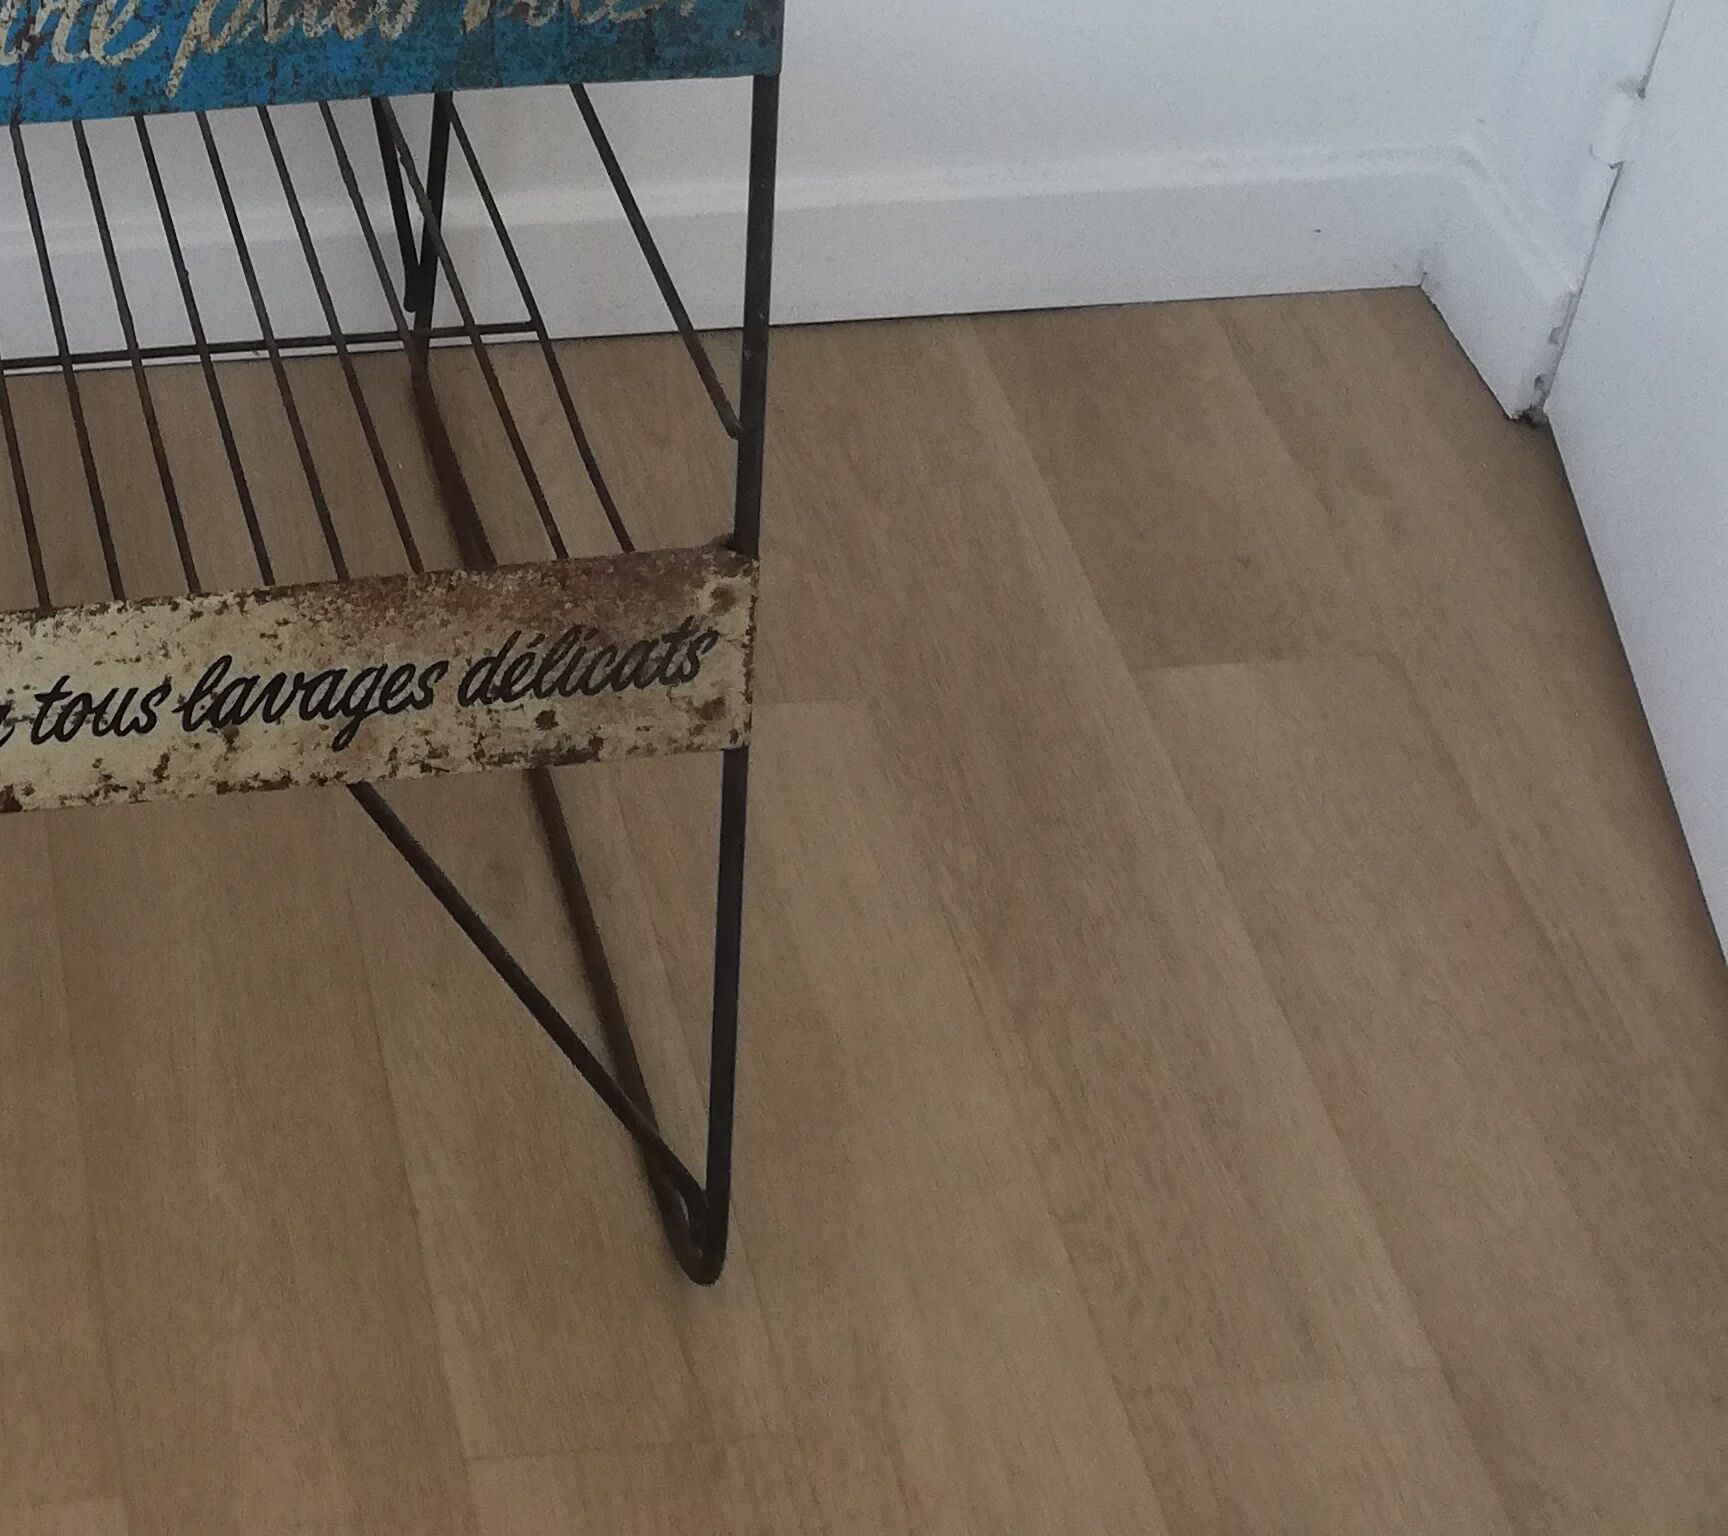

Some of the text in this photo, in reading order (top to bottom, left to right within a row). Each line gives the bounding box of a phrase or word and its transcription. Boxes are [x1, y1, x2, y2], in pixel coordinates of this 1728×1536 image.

[29, 675, 173, 746] tous
[177, 654, 450, 752] lavages
[457, 615, 720, 708] délicats
